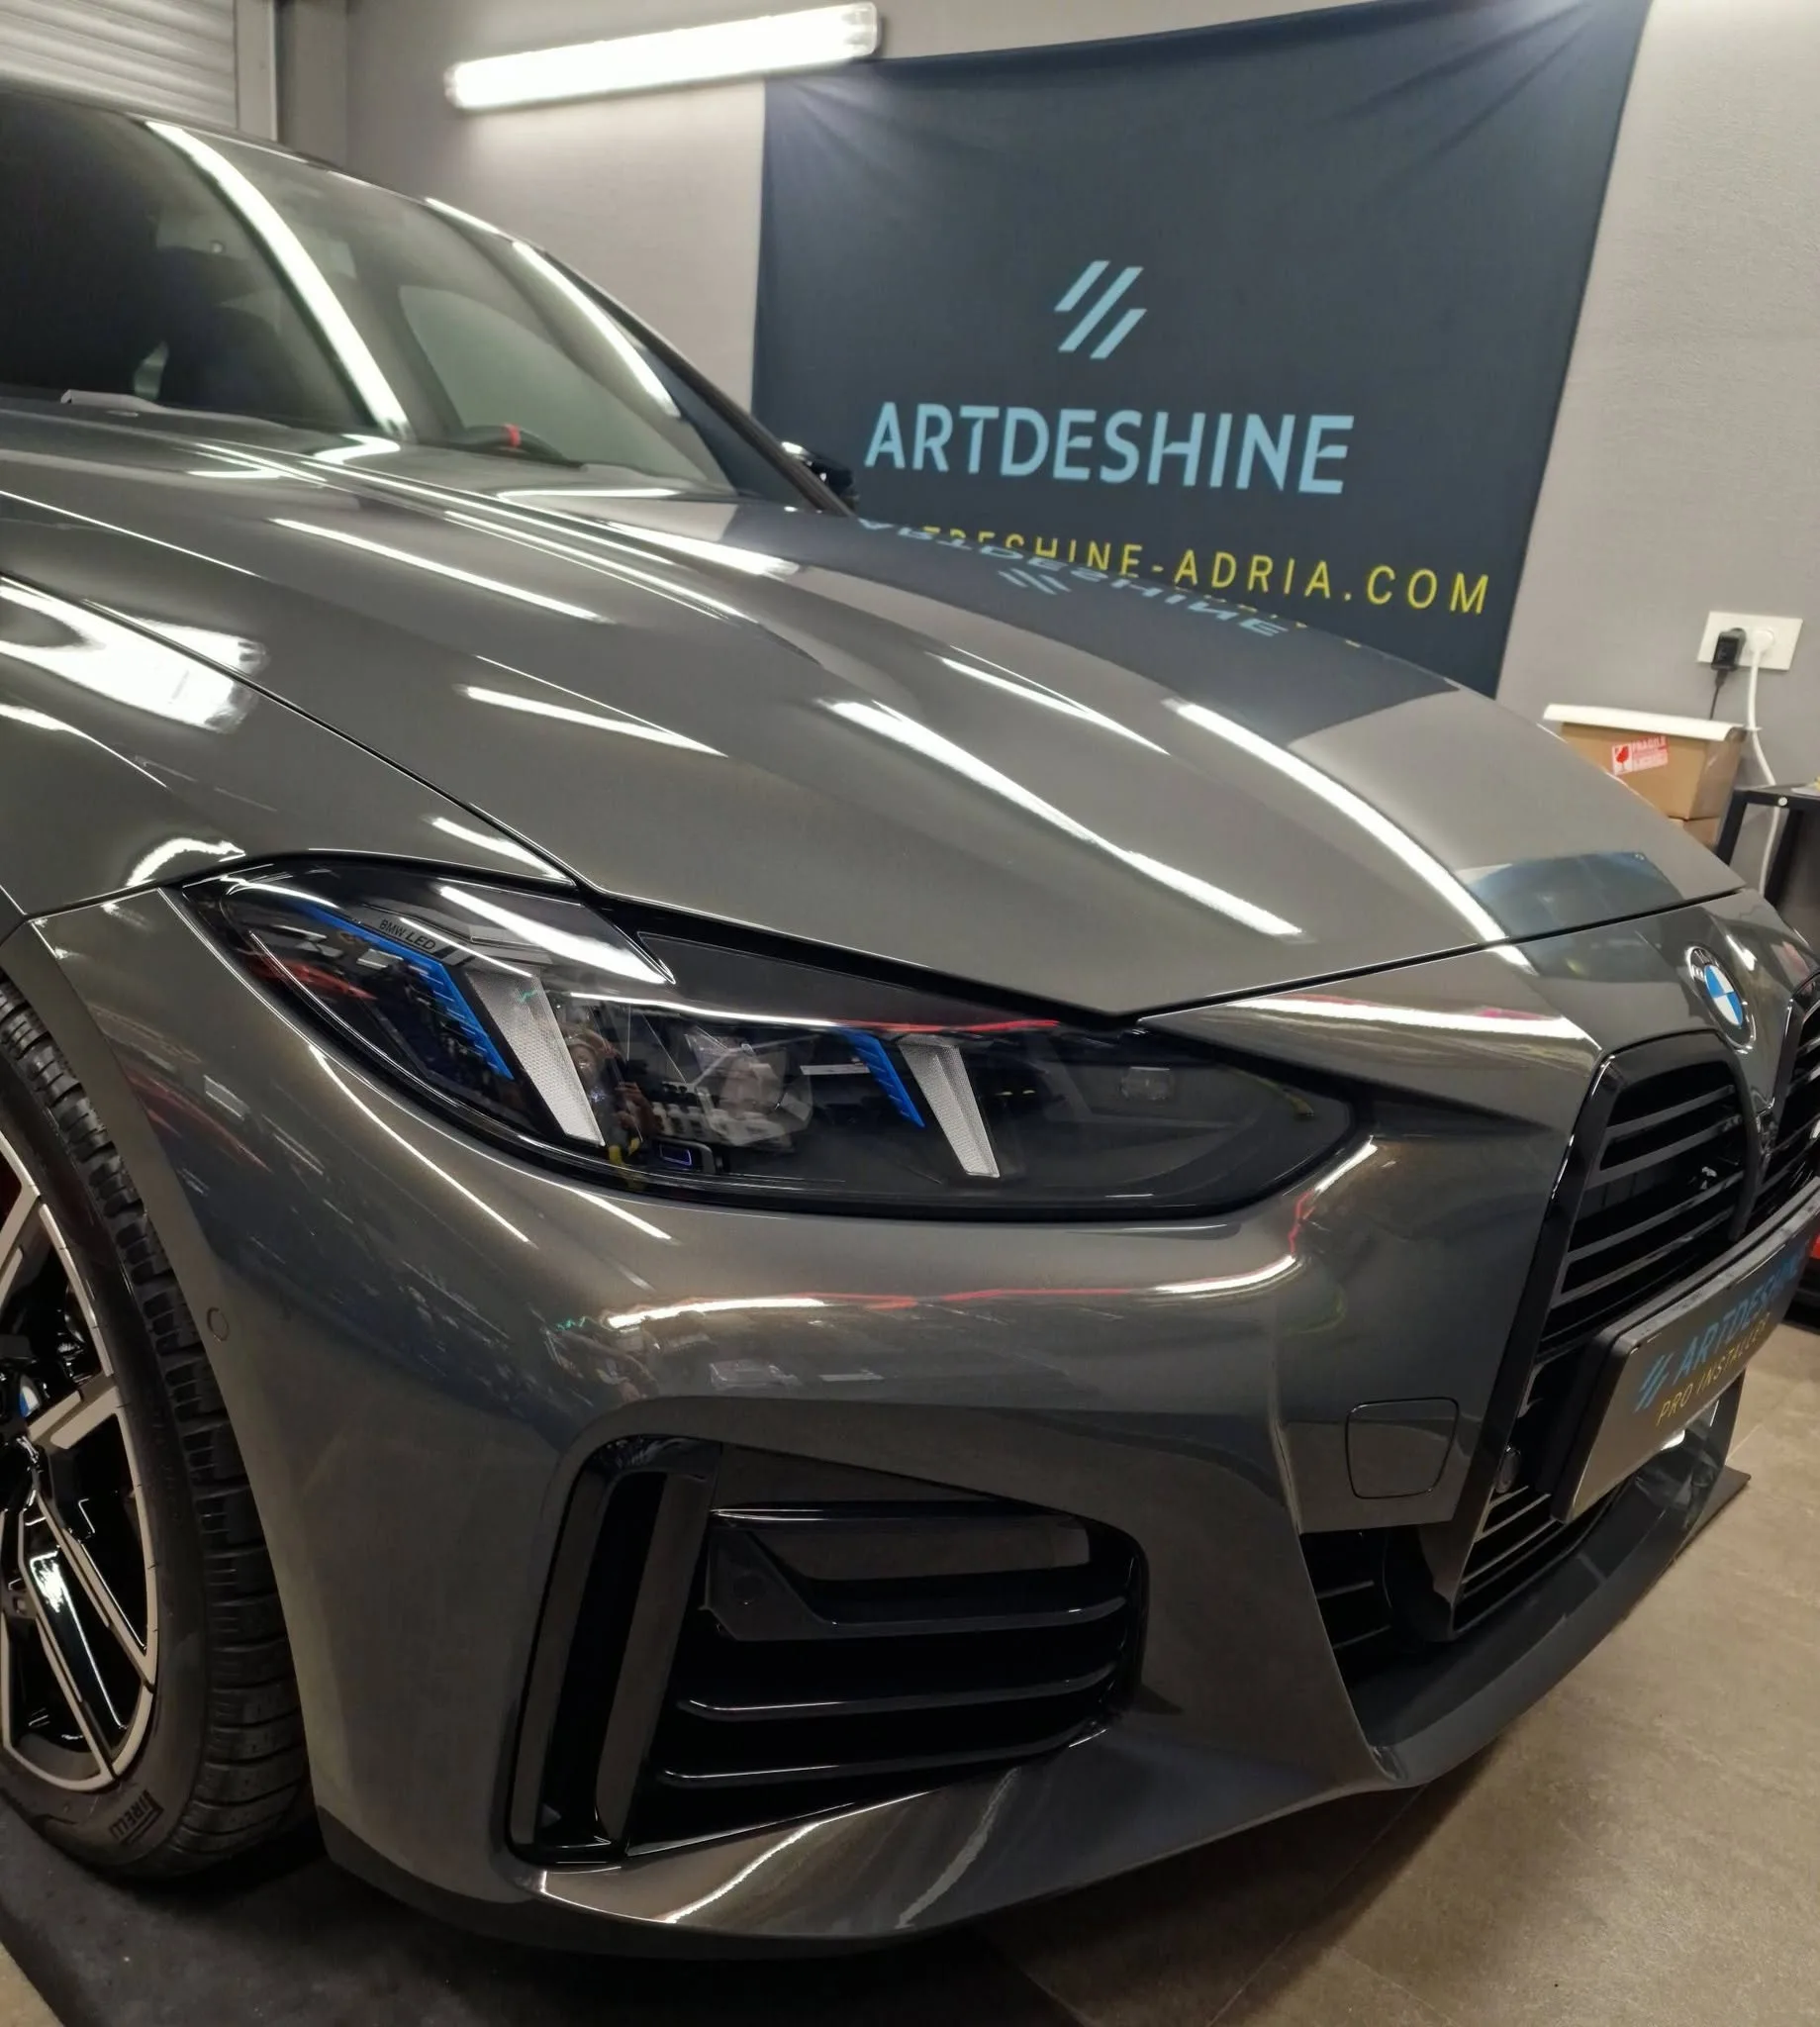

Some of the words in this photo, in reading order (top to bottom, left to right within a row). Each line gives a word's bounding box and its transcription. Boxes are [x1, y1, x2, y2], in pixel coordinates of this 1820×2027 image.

[864, 401, 1354, 494] ARTDESHINE
[379, 918, 407, 937] BMW
[405, 930, 436, 950] LED
[1672, 1247, 1801, 1386] ARTDES
[1655, 1383, 1693, 1426] PRO
[108, 1788, 165, 1846] PIRELLI
